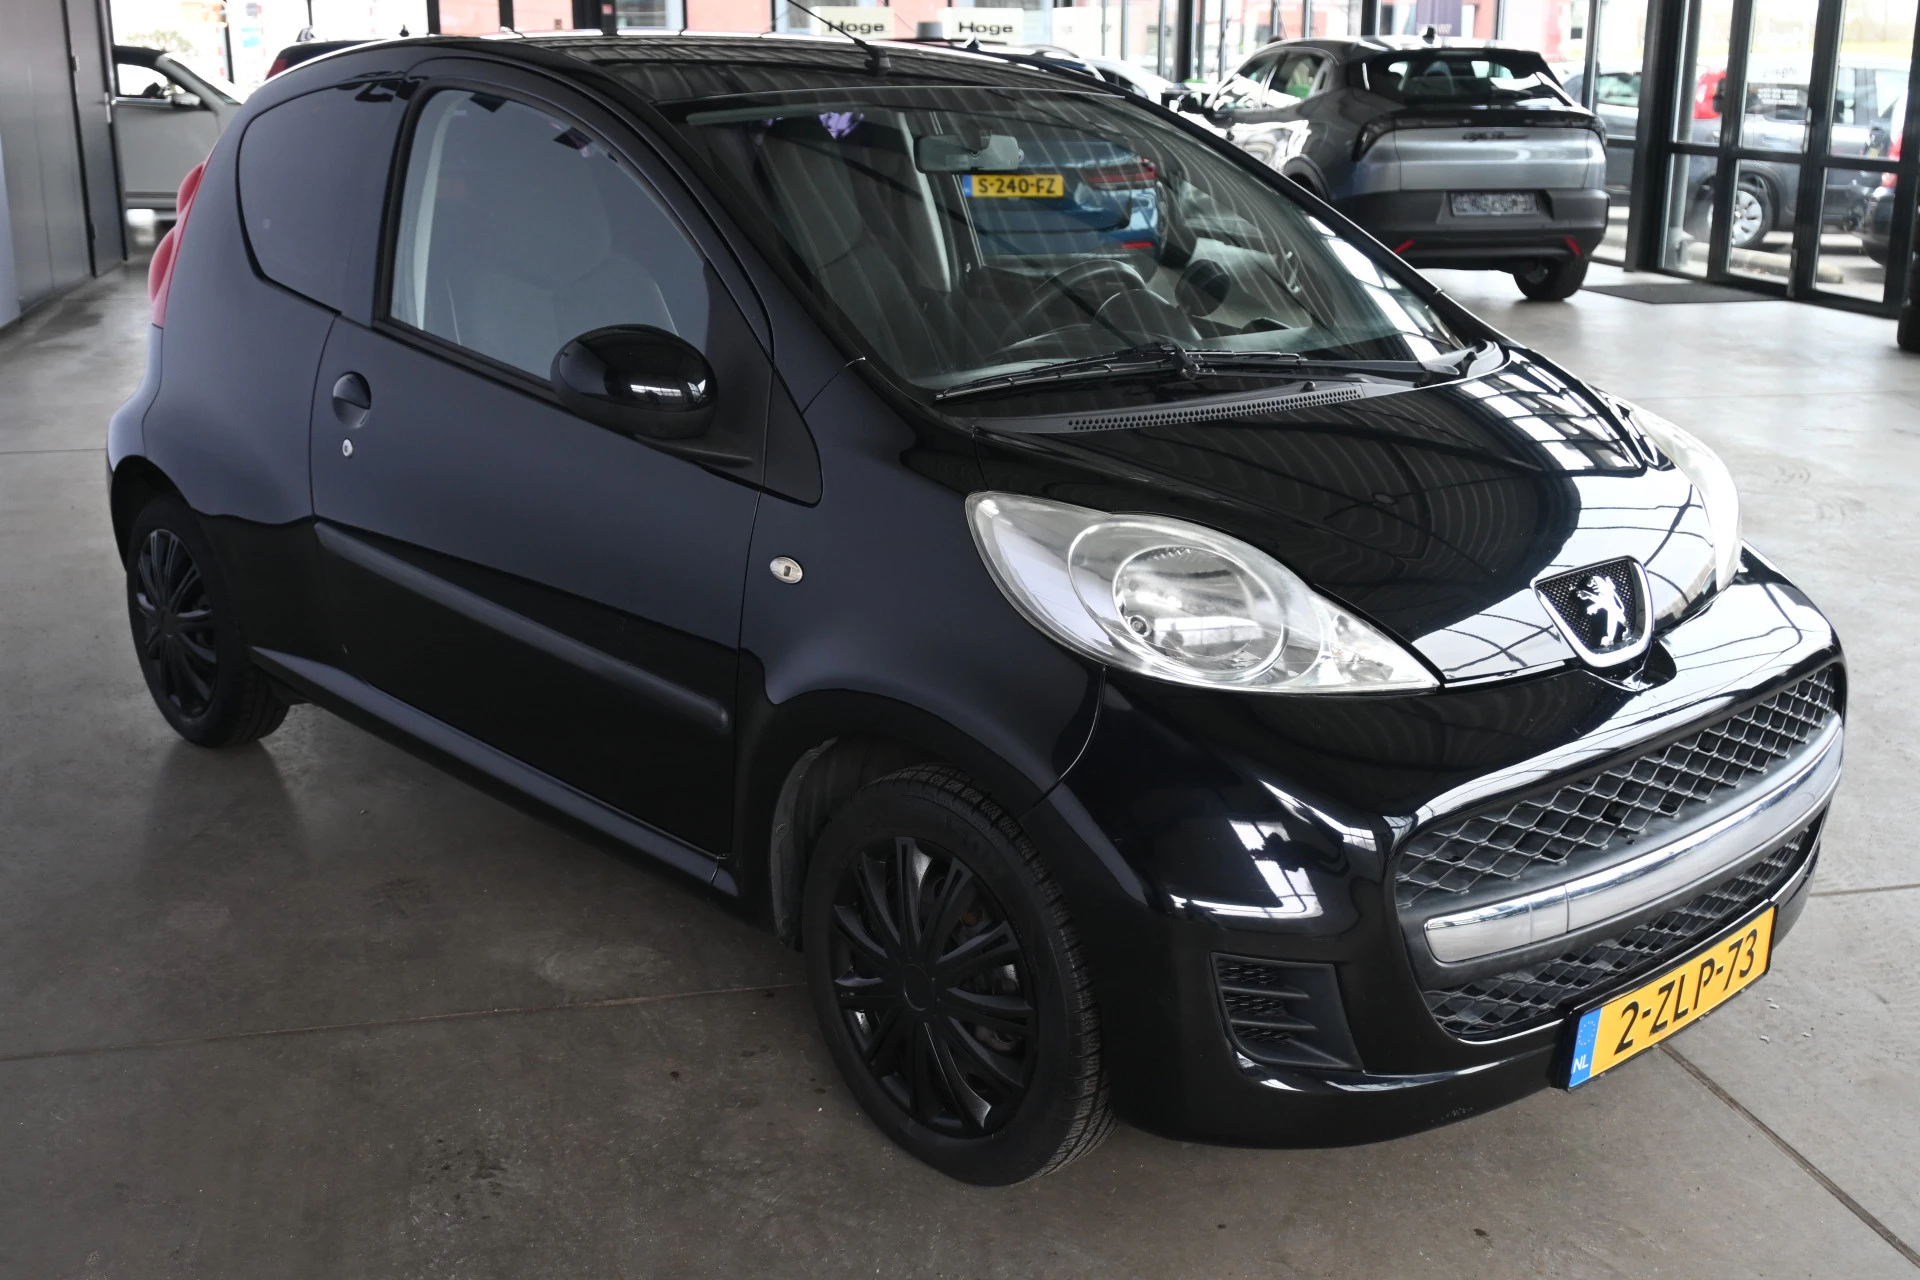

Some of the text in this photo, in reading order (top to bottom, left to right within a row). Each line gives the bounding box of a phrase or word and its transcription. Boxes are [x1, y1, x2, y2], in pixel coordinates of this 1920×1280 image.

[828, 20, 884, 34] Hoge
[958, 21, 1013, 35] Hoge
[978, 177, 1056, 193] S-240-FZ
[1573, 928, 1758, 1073] NL 2-ZLP-73
